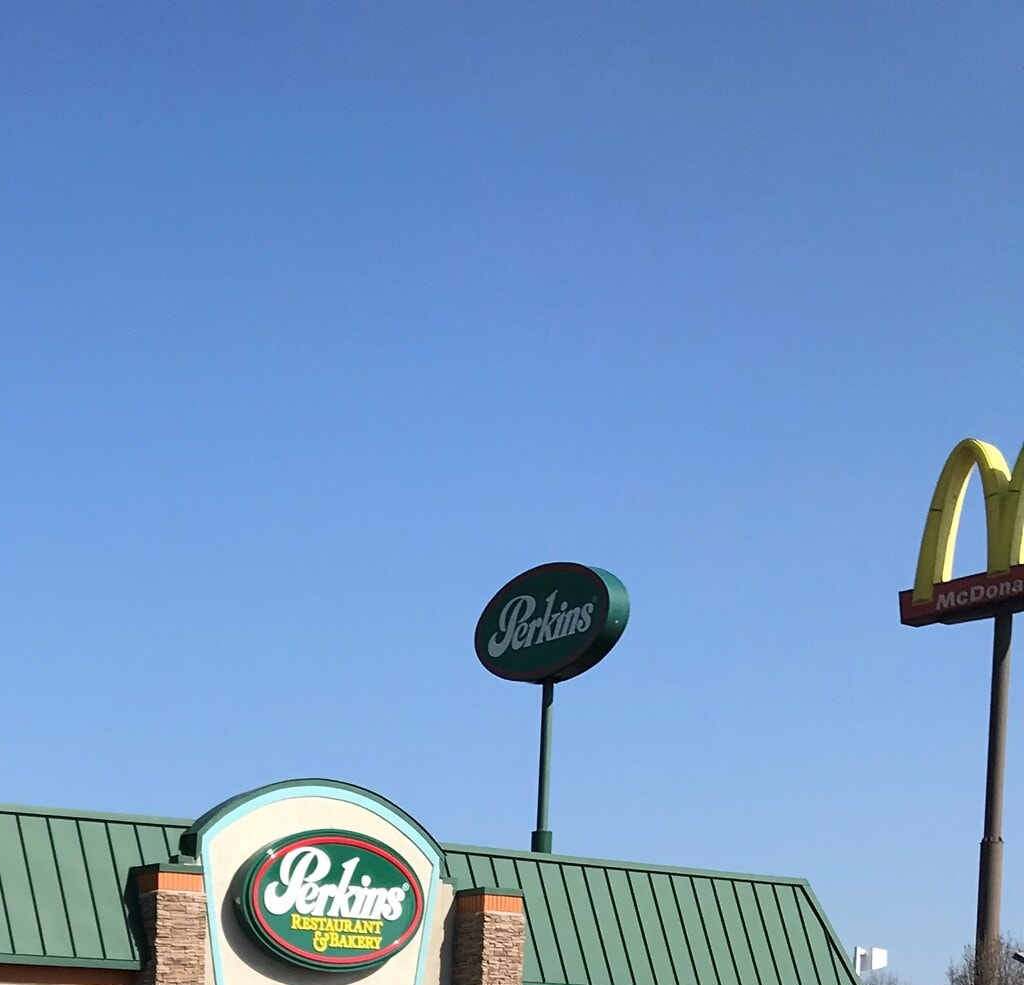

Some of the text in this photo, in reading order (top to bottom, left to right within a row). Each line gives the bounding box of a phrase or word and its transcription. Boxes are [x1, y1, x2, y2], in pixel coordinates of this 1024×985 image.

[488, 589, 594, 658] Perkins
[264, 846, 406, 921] Perkins
[291, 913, 384, 934] RESTAURANT
